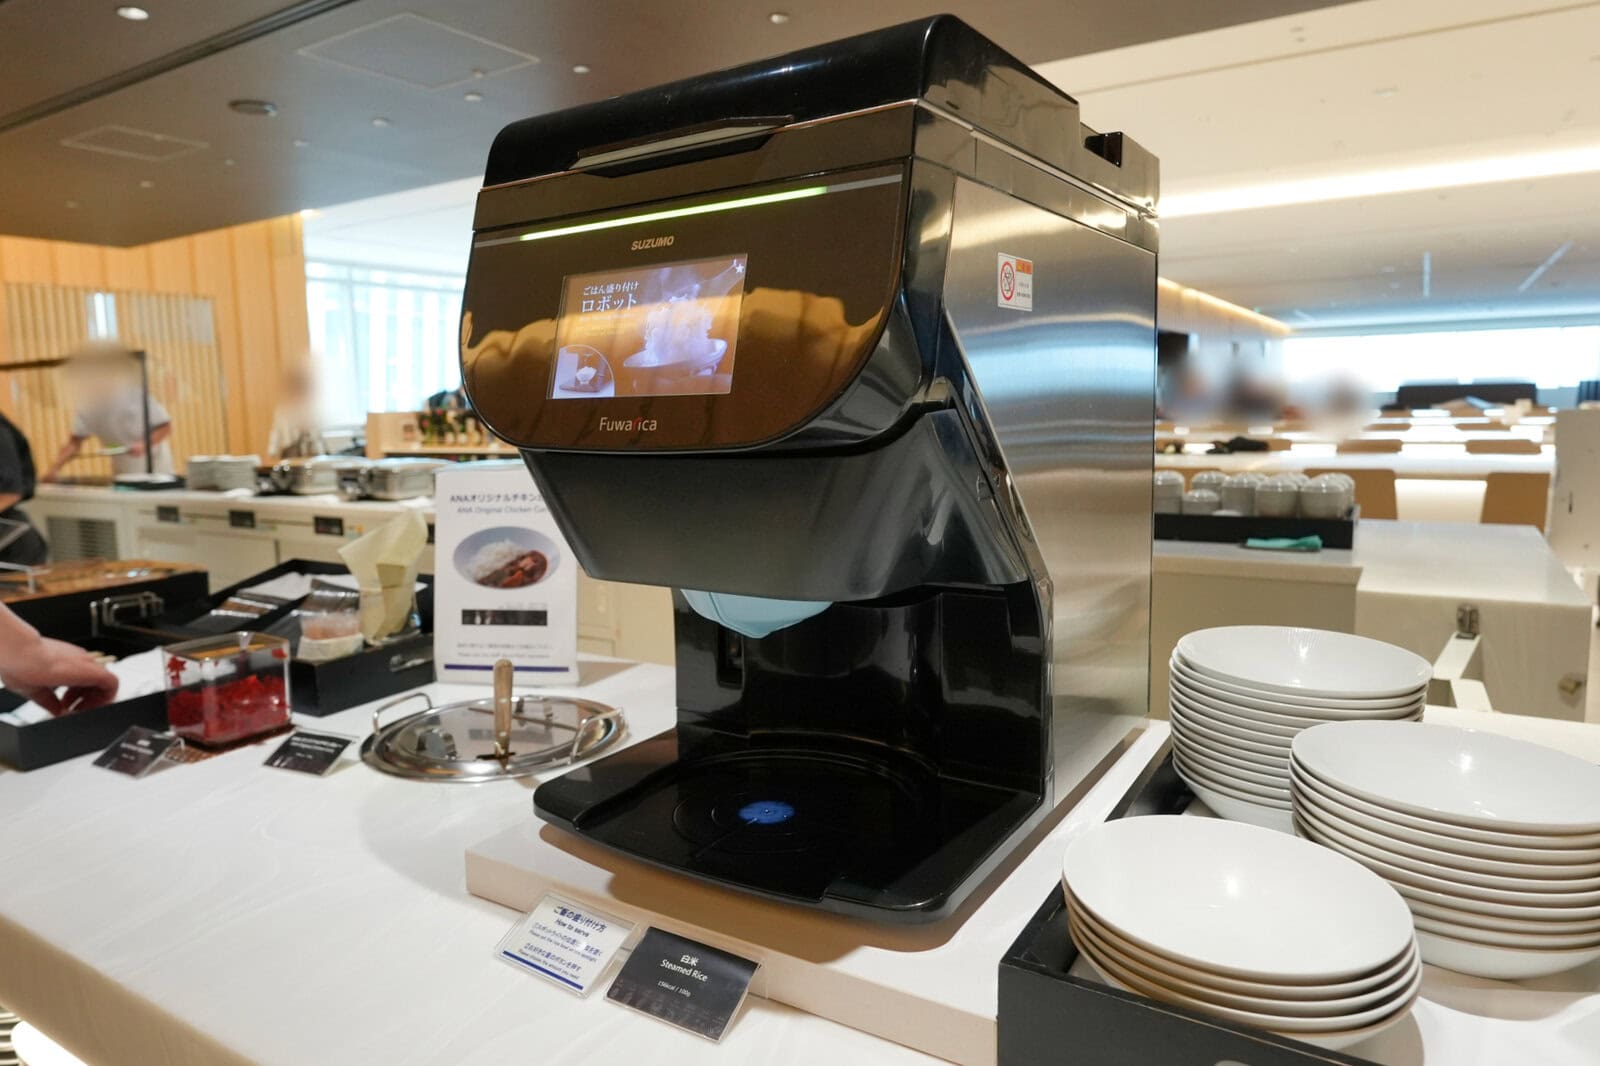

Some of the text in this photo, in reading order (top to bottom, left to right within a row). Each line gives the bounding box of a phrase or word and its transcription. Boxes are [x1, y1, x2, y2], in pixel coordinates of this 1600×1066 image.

[631, 235, 675, 251] SUZUMO
[583, 281, 640, 296] ごはん盛り付け
[581, 293, 637, 313] ロボット
[599, 416, 657, 431] Fuwarica
[555, 918, 590, 938] How to serve
[680, 954, 699, 967] 白米
[660, 958, 709, 982] Steamed Rice
